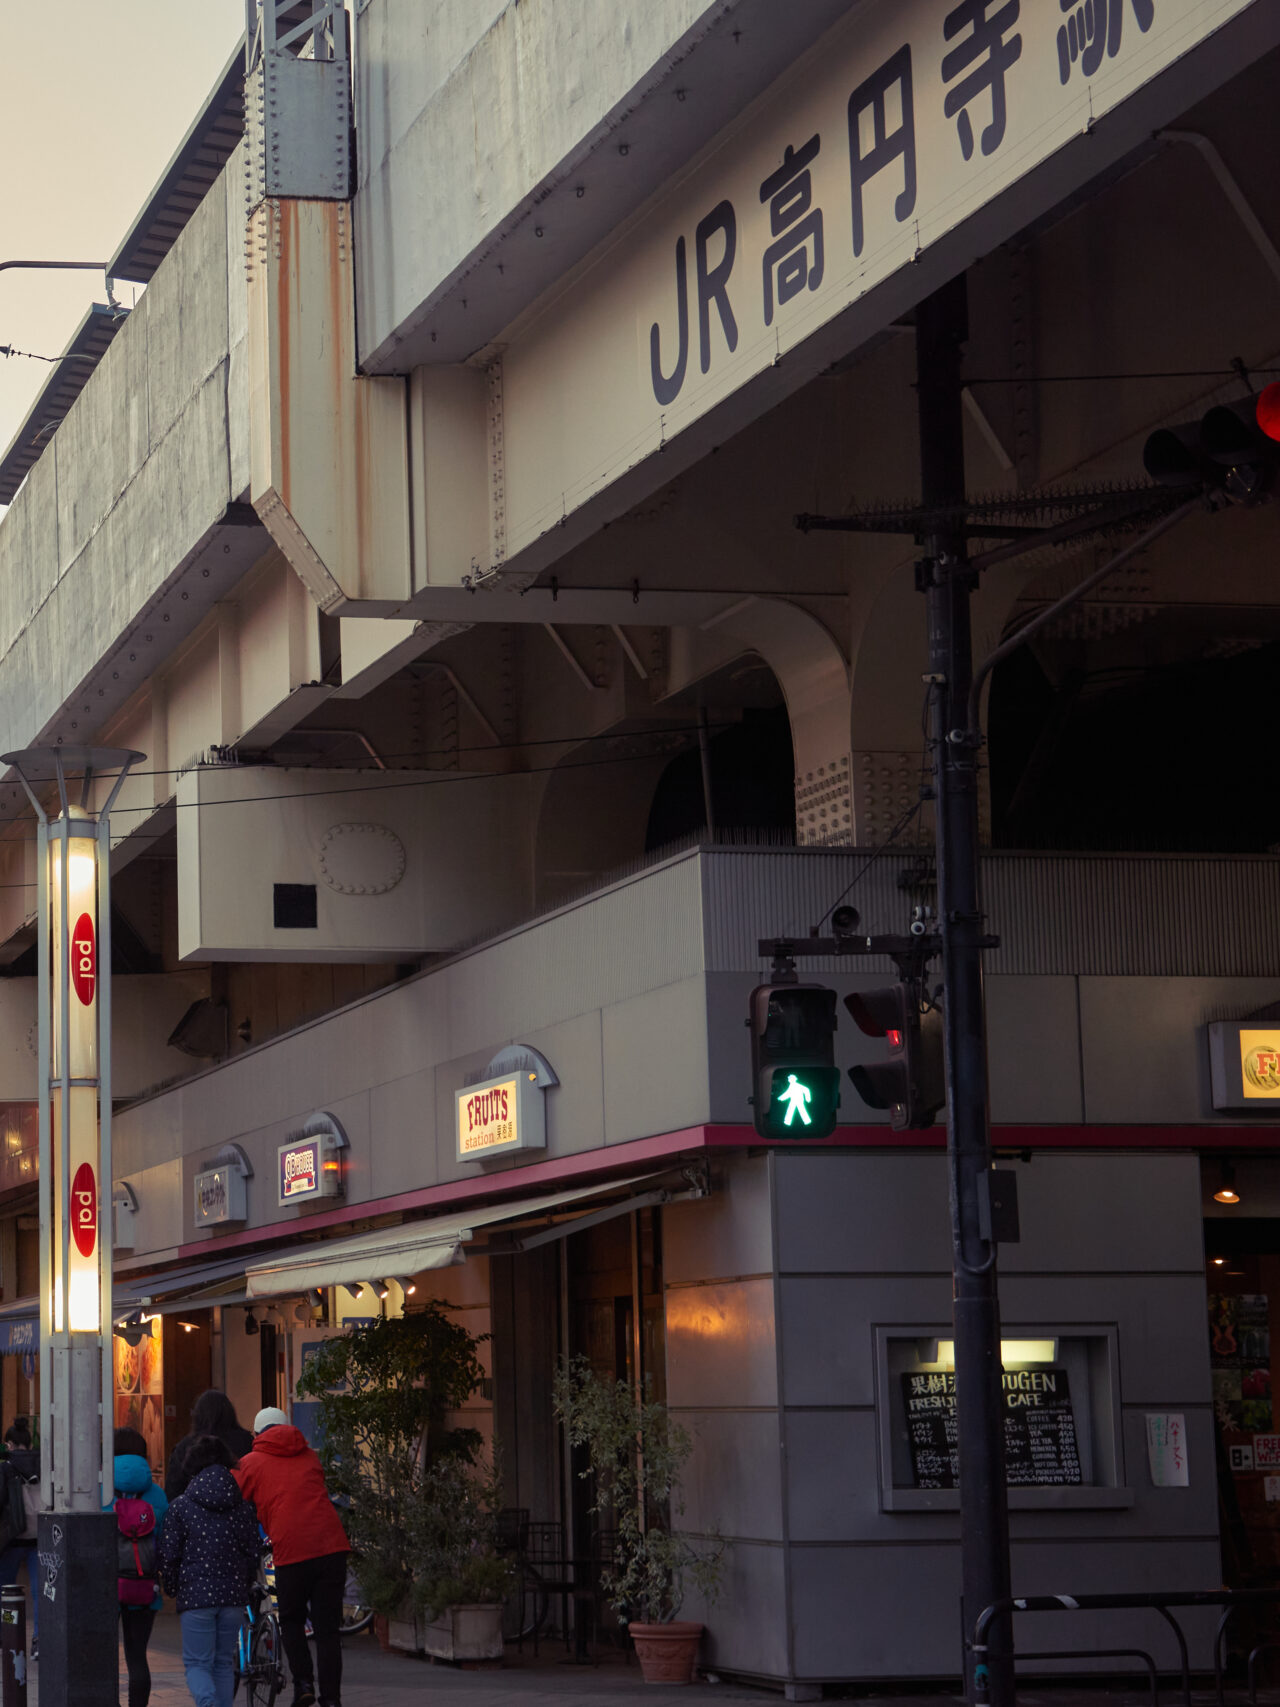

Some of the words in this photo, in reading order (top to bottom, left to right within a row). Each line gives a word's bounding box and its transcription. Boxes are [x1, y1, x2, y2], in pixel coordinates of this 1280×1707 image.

[75, 940, 95, 978] pal
[467, 1088, 508, 1132] FRUITS
[465, 1131, 495, 1150] station
[75, 1191, 96, 1230] pal
[1007, 1393, 1045, 1408] CAFE
